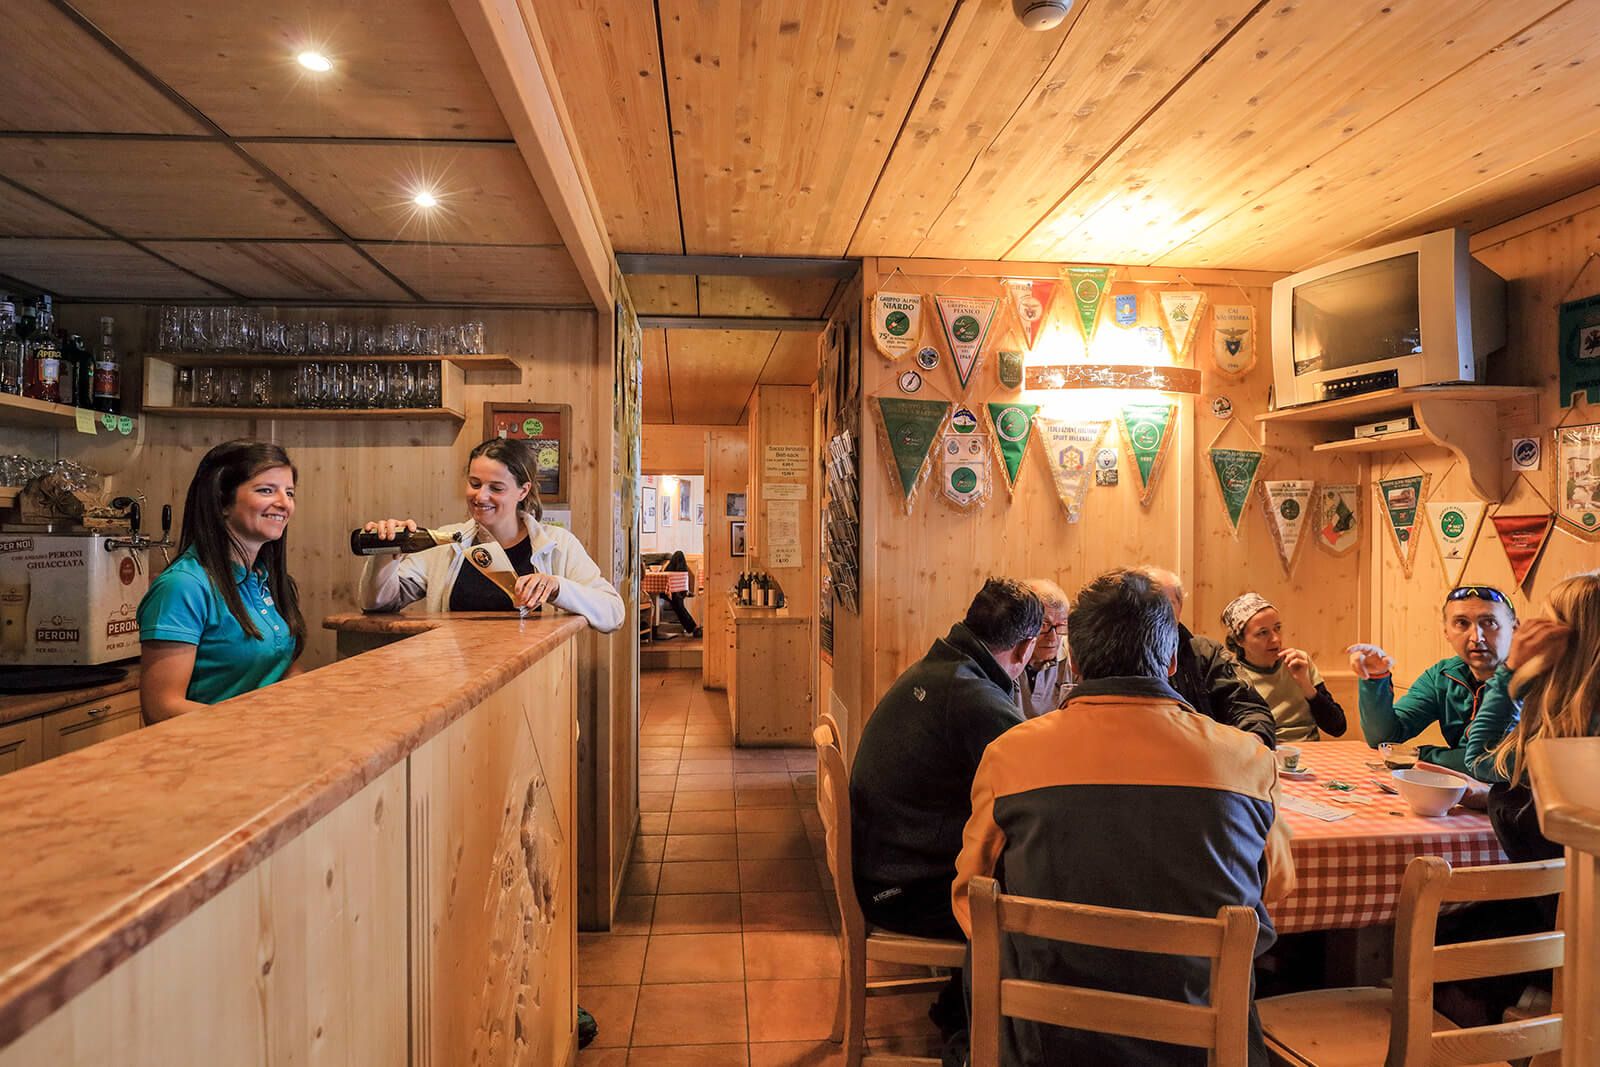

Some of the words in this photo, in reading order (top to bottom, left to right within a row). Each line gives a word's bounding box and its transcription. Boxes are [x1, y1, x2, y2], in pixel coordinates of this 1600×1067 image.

[883, 302, 915, 310] NIARDO
[16, 539, 32, 549] NOI
[48, 550, 82, 559] PERONI
[27, 559, 84, 569] GHIACCIATA
[38, 631, 77, 640] PERONI
